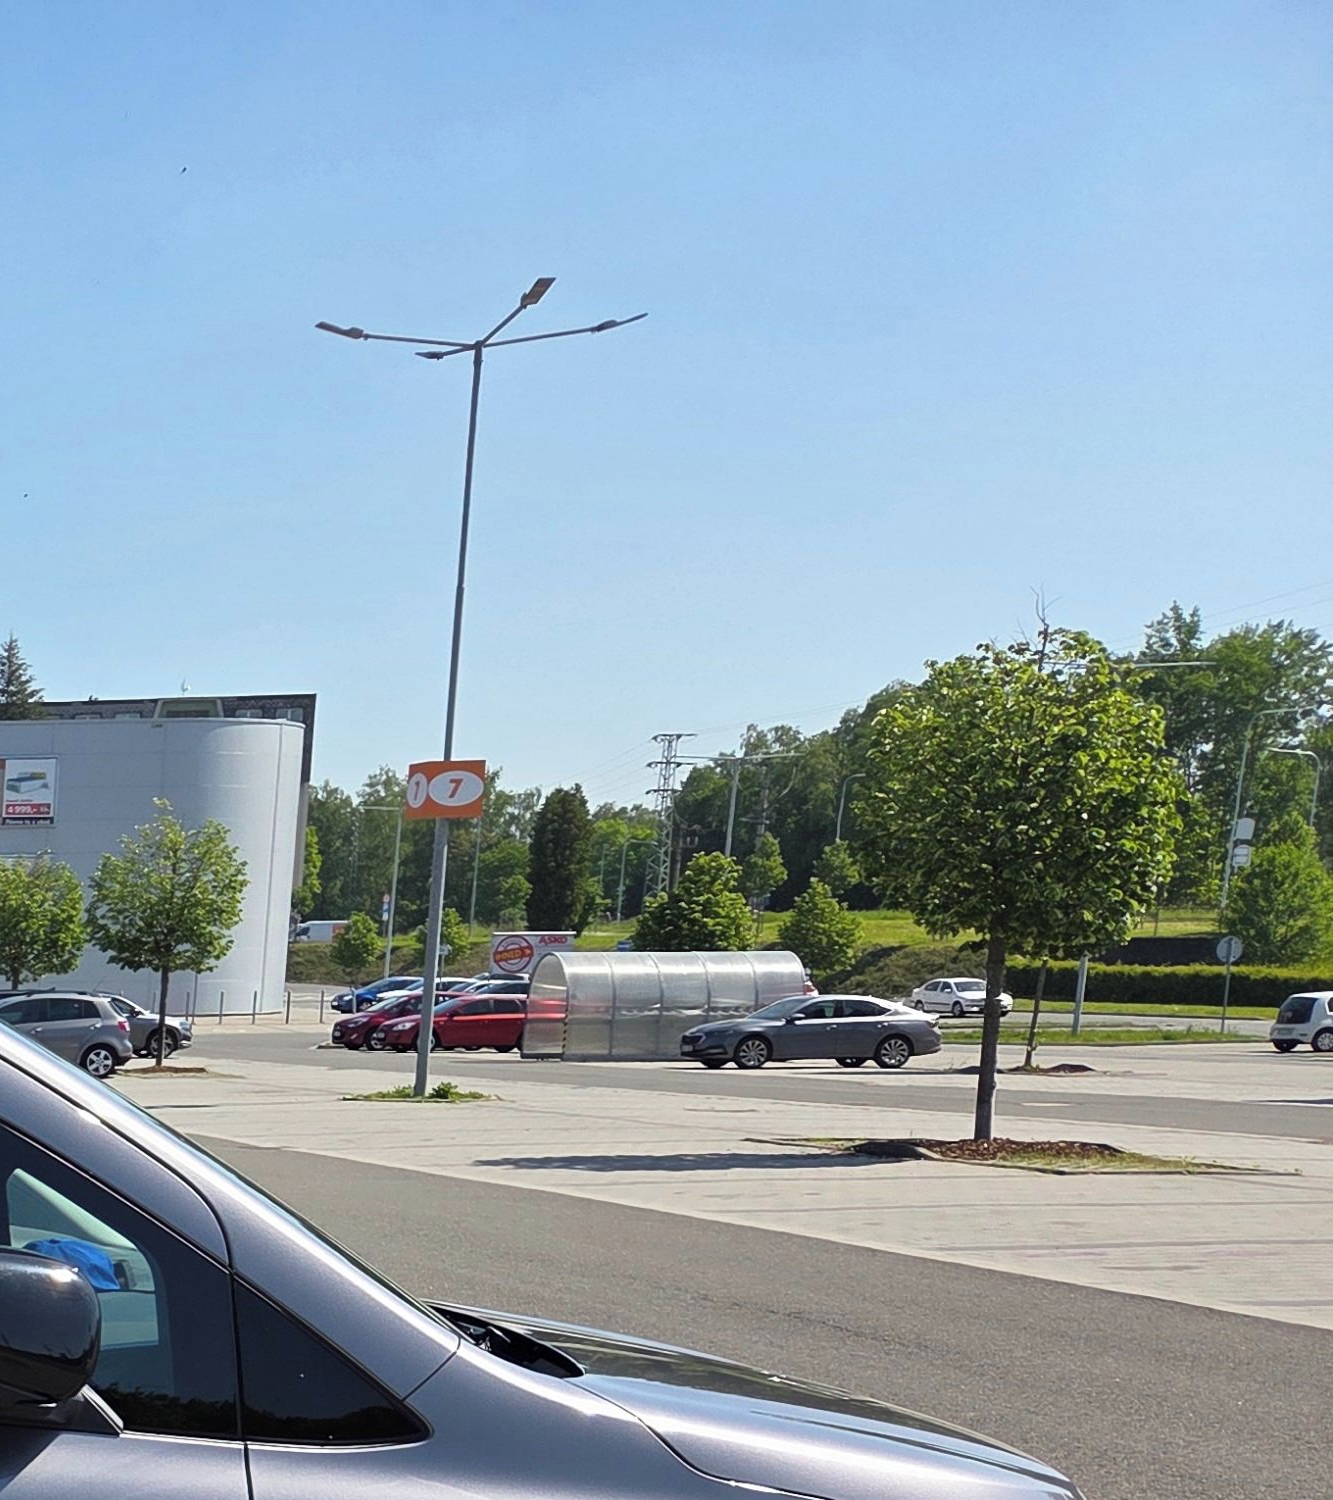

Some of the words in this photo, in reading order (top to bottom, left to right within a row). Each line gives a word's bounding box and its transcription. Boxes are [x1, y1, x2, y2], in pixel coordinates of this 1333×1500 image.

[412, 780, 421, 800] 1
[447, 778, 464, 798] 7
[539, 935, 568, 945] ASKO
